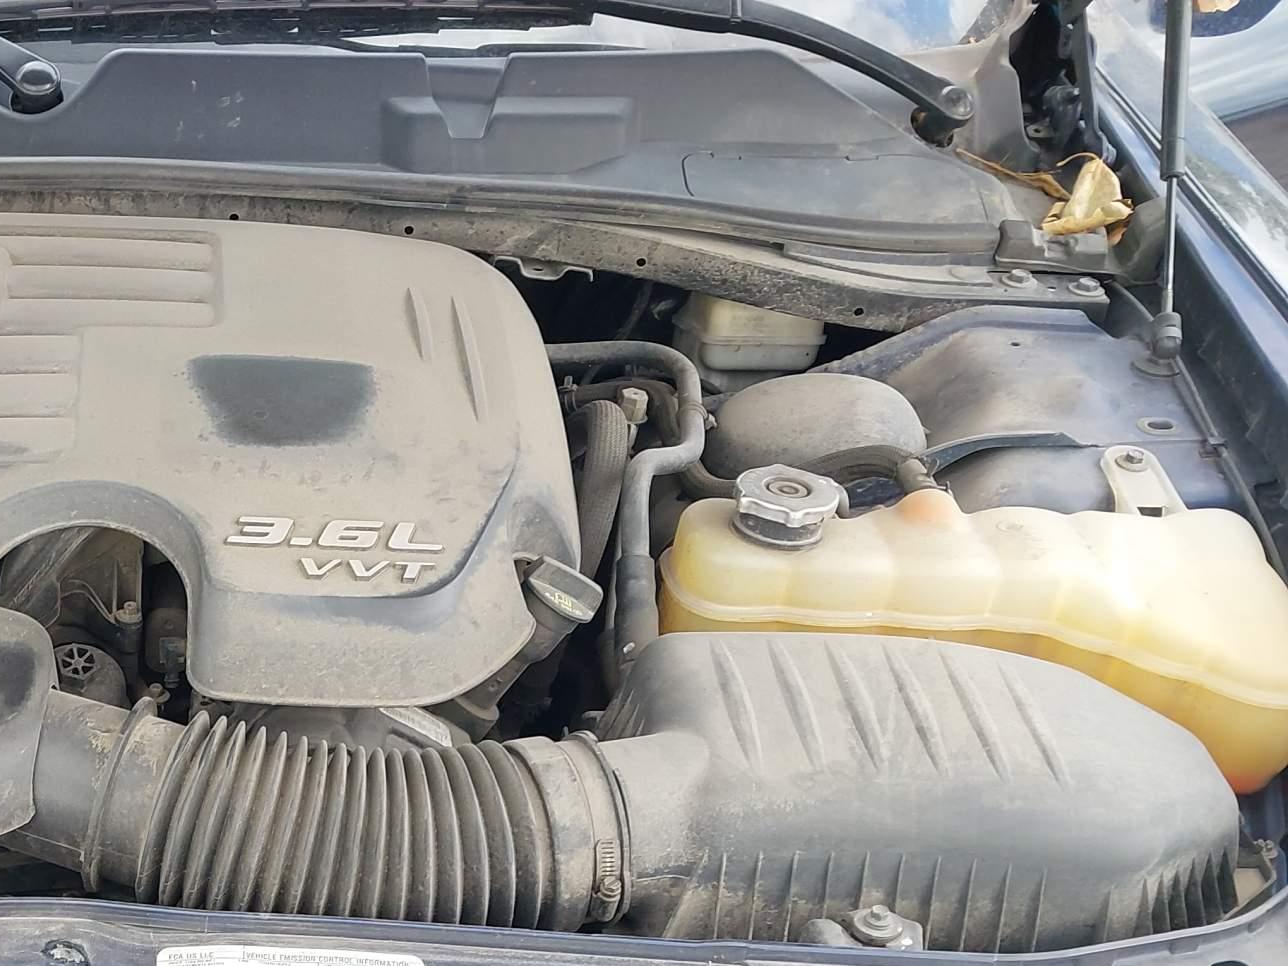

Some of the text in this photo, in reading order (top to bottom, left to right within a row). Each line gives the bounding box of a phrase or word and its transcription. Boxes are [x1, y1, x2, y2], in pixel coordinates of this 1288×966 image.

[224, 516, 445, 553] 3.6L
[300, 557, 436, 583] VVT
[200, 951, 214, 959] LLC
[246, 952, 276, 961] VEHICLE
[279, 954, 316, 963] EMISSION
[318, 956, 353, 965] CONTROL
